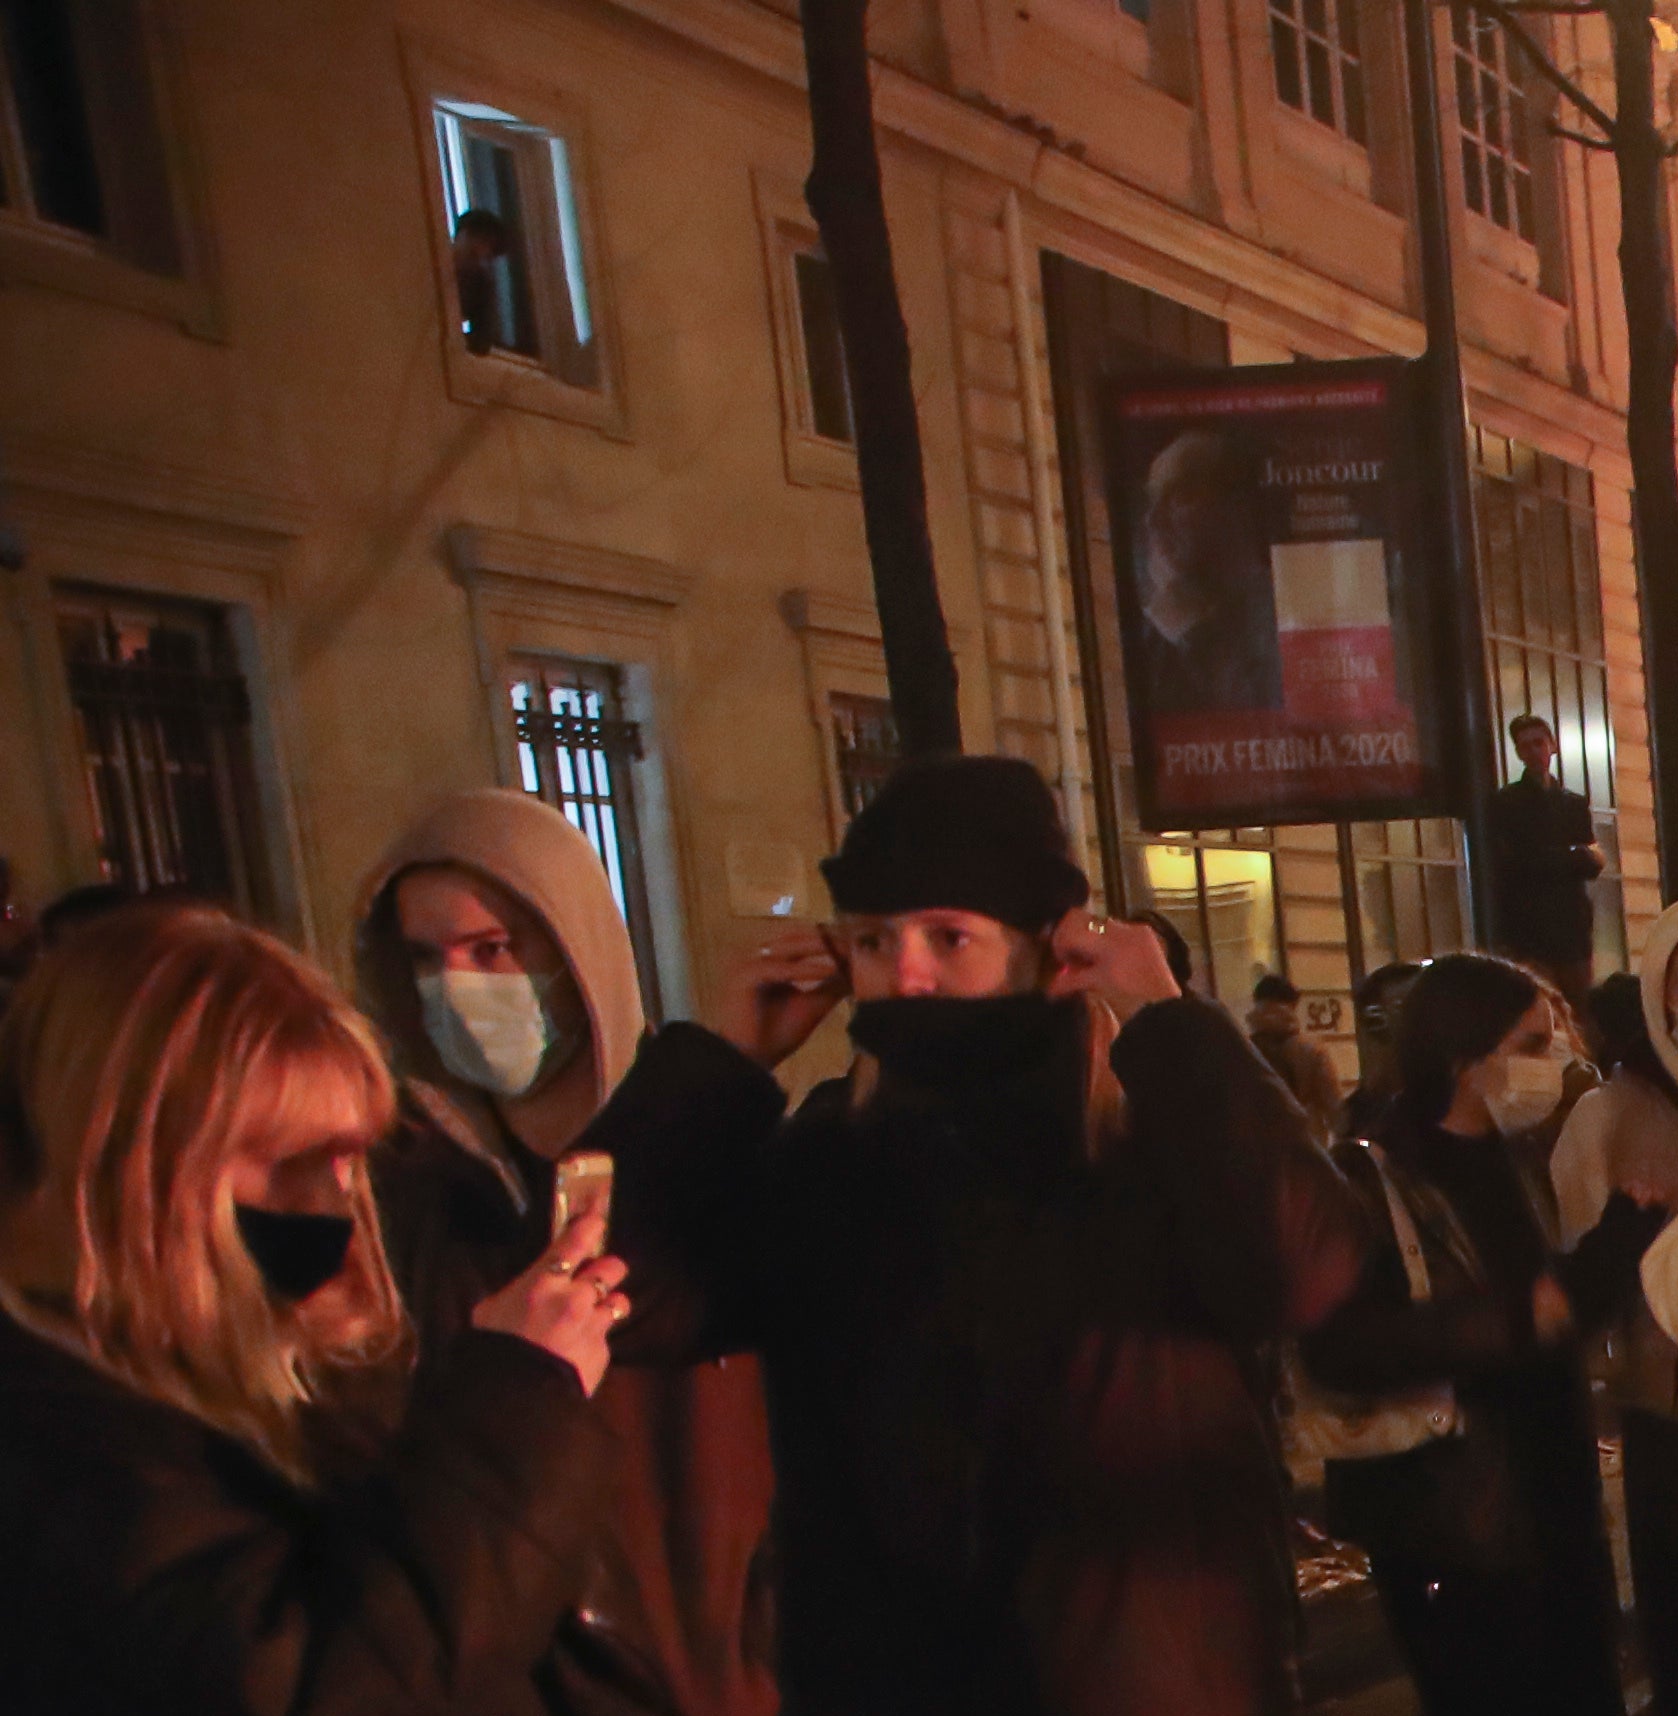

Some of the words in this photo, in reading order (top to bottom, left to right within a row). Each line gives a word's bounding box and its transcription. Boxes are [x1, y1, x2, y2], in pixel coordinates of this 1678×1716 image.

[1259, 456, 1385, 487] Joncour
[1162, 742, 1228, 777] PRIX
[1232, 734, 1337, 773] FEMINA
[1340, 729, 1411, 768] 2020
